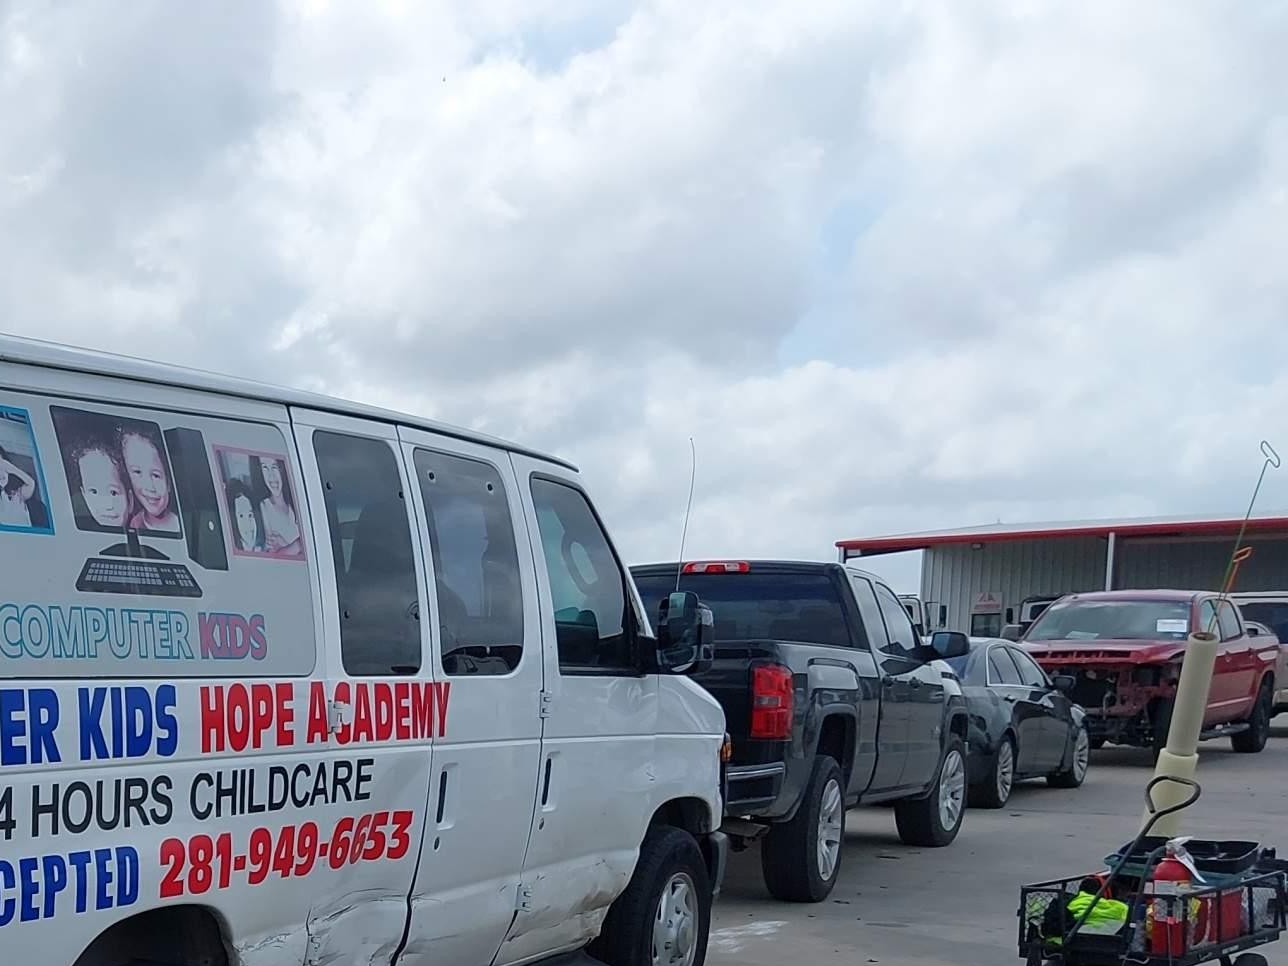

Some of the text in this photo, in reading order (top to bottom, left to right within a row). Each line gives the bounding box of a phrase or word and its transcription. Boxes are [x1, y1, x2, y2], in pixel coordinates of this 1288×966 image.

[198, 612, 268, 661] KIDS
[77, 684, 179, 760] KIDS
[199, 682, 294, 754] HOPE
[306, 681, 451, 745] ACADEMY
[31, 775, 173, 838] HOURS
[190, 758, 374, 821] CHILDCARE
[159, 810, 414, 899] 281-949-6653
